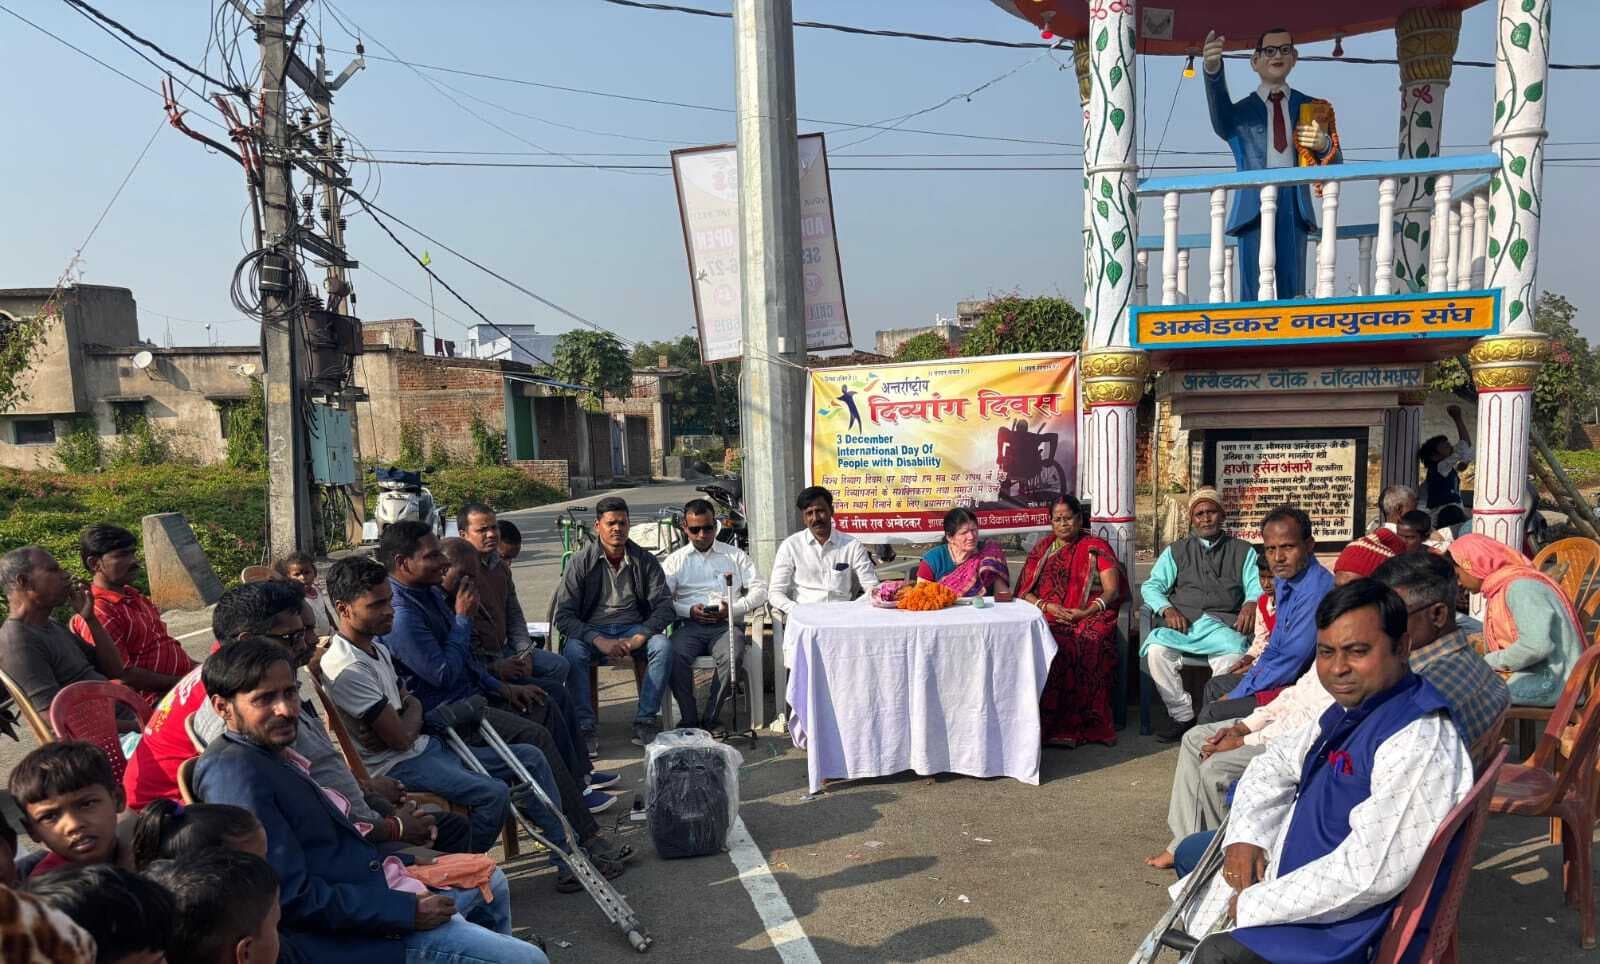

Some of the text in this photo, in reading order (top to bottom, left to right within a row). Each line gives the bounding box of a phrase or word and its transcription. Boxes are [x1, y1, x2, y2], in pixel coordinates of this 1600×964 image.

[1151, 302, 1475, 337] अम्बेडकर नवयुवक संघ
[868, 388, 1063, 425] दिव्यांग दिवस
[837, 434, 893, 444] 3 December
[838, 443, 933, 456] International Day Of
[838, 456, 941, 469] People with Disability
[1224, 461, 1251, 475] हाजी
[1280, 459, 1312, 475] अंसारी
